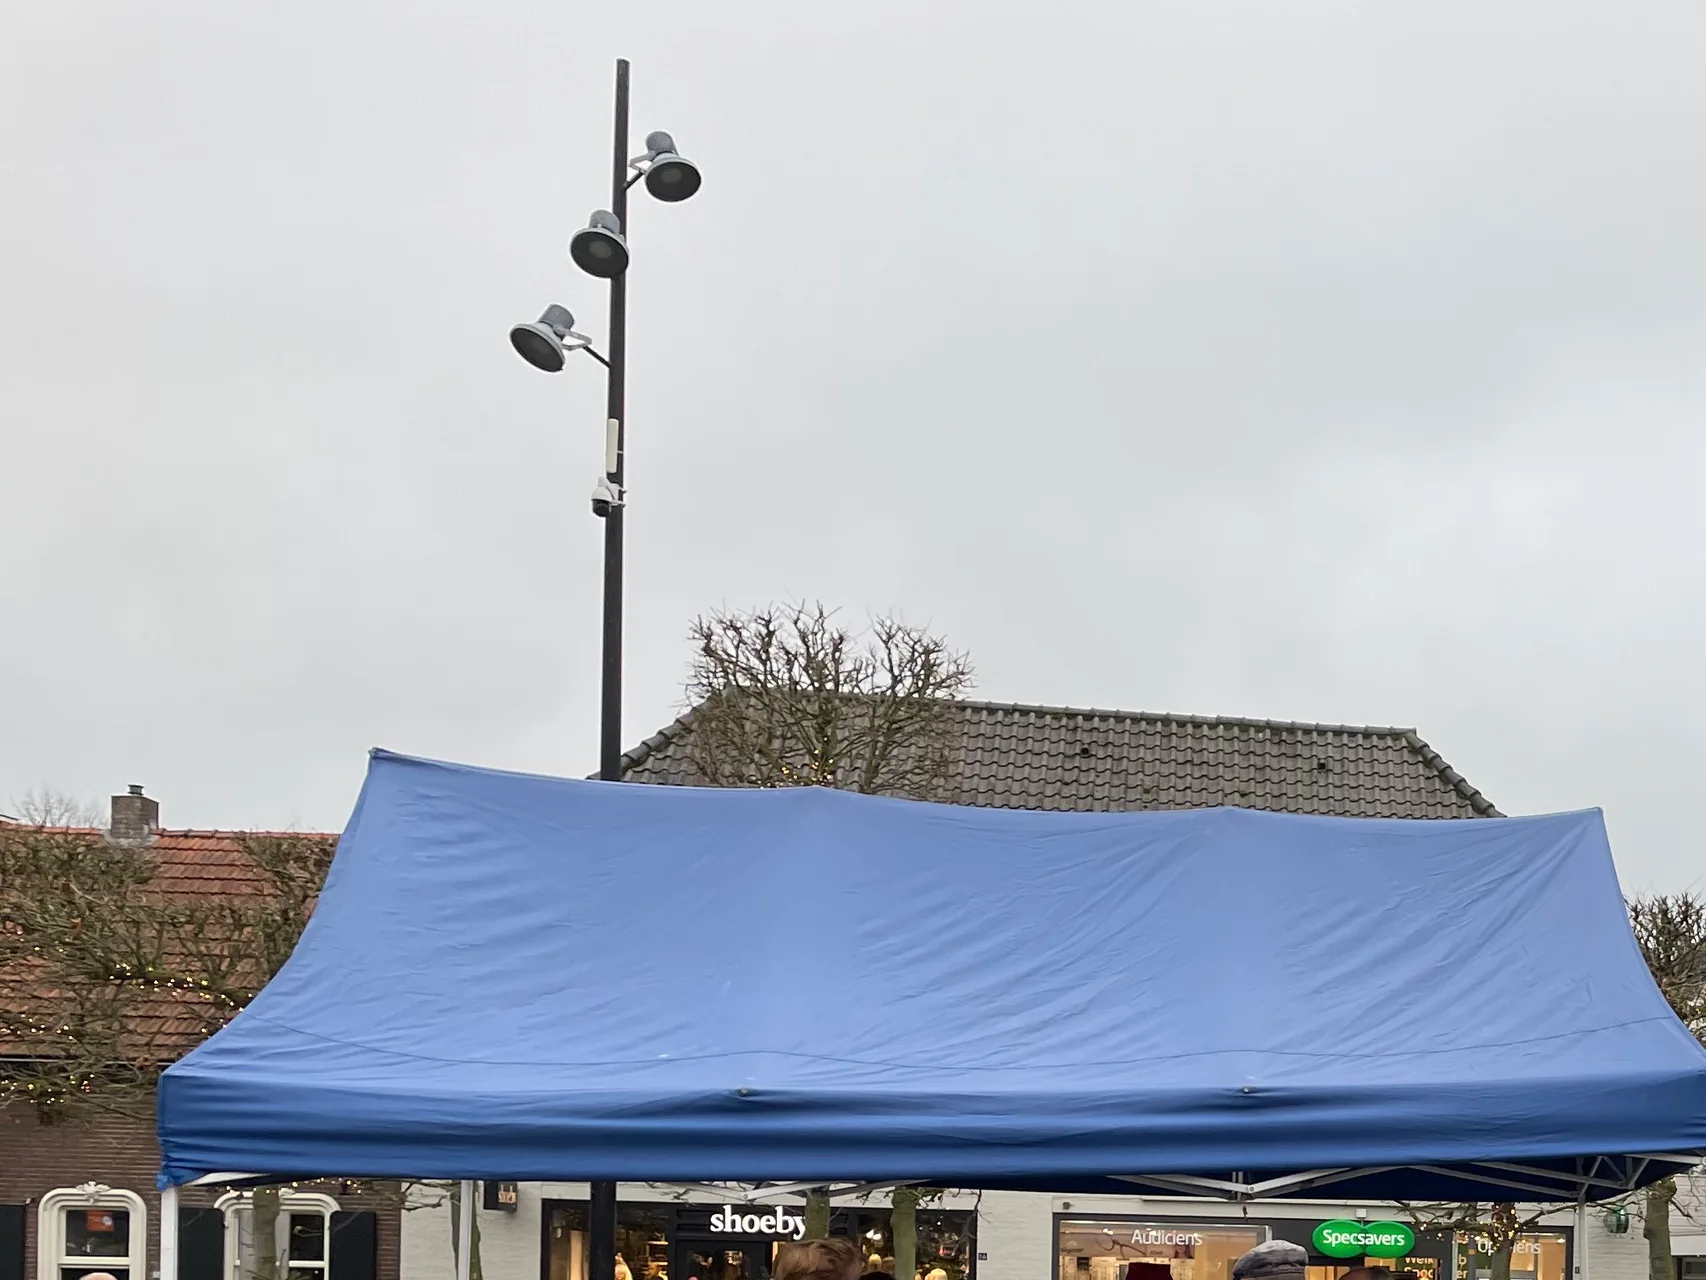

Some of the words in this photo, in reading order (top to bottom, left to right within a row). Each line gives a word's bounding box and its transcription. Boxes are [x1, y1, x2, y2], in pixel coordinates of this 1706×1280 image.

[710, 1204, 806, 1240] shoeby
[1131, 1229, 1203, 1246] Audiciens
[1322, 1229, 1405, 1247] Specsavers
